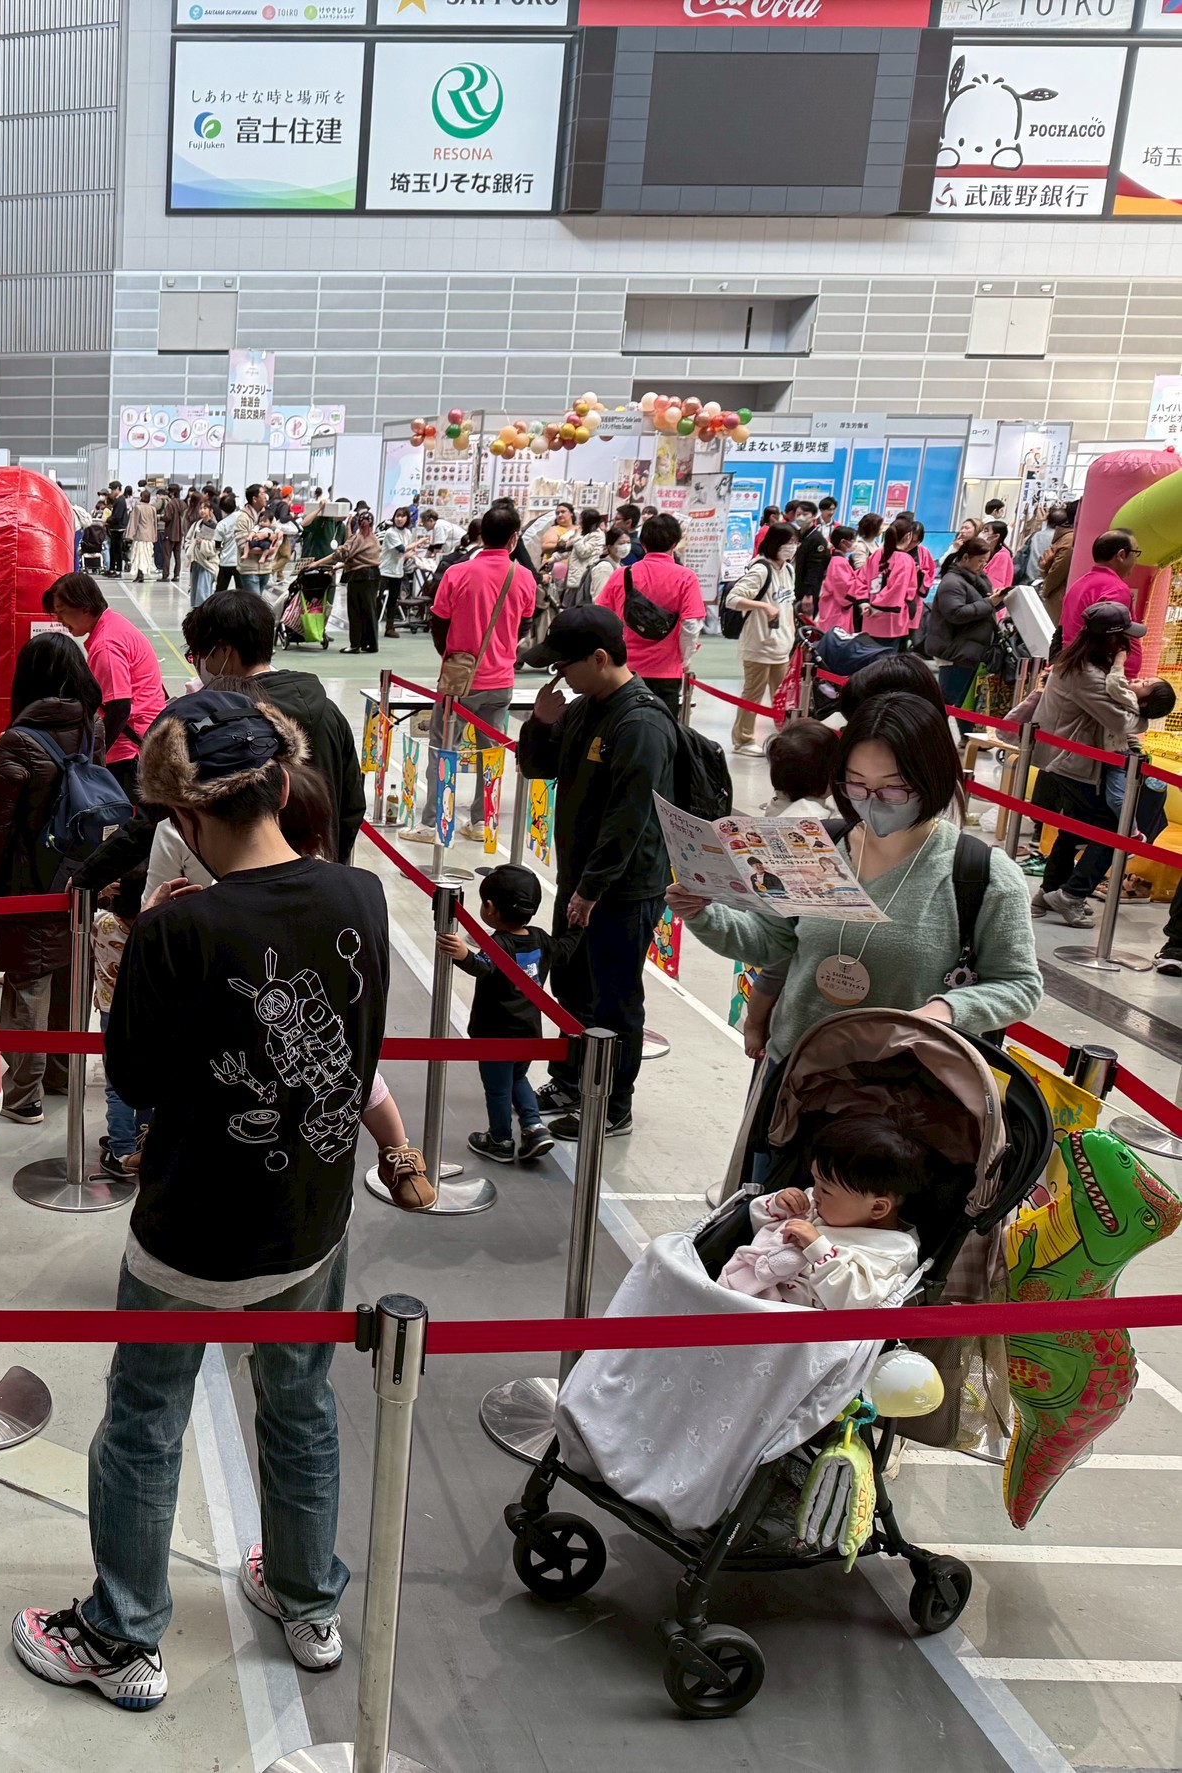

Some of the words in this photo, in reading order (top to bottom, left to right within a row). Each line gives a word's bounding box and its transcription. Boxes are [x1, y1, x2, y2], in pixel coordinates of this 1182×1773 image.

[278, 8, 299, 17] TOIRO
[191, 89, 346, 105] しあわせな時と場所を
[236, 117, 343, 145] 富士住建
[1029, 124, 1106, 138] POCHACCO
[433, 147, 493, 161] RESONA
[390, 172, 534, 195] 埼玉りそな銀行
[965, 184, 1090, 208] 武蔵野銀行
[241, 396, 260, 407] 抽選会
[1156, 404, 1182, 412] ハイハ
[234, 409, 266, 420] 賞品交換所
[736, 441, 829, 453] 望まない受動喫煙
